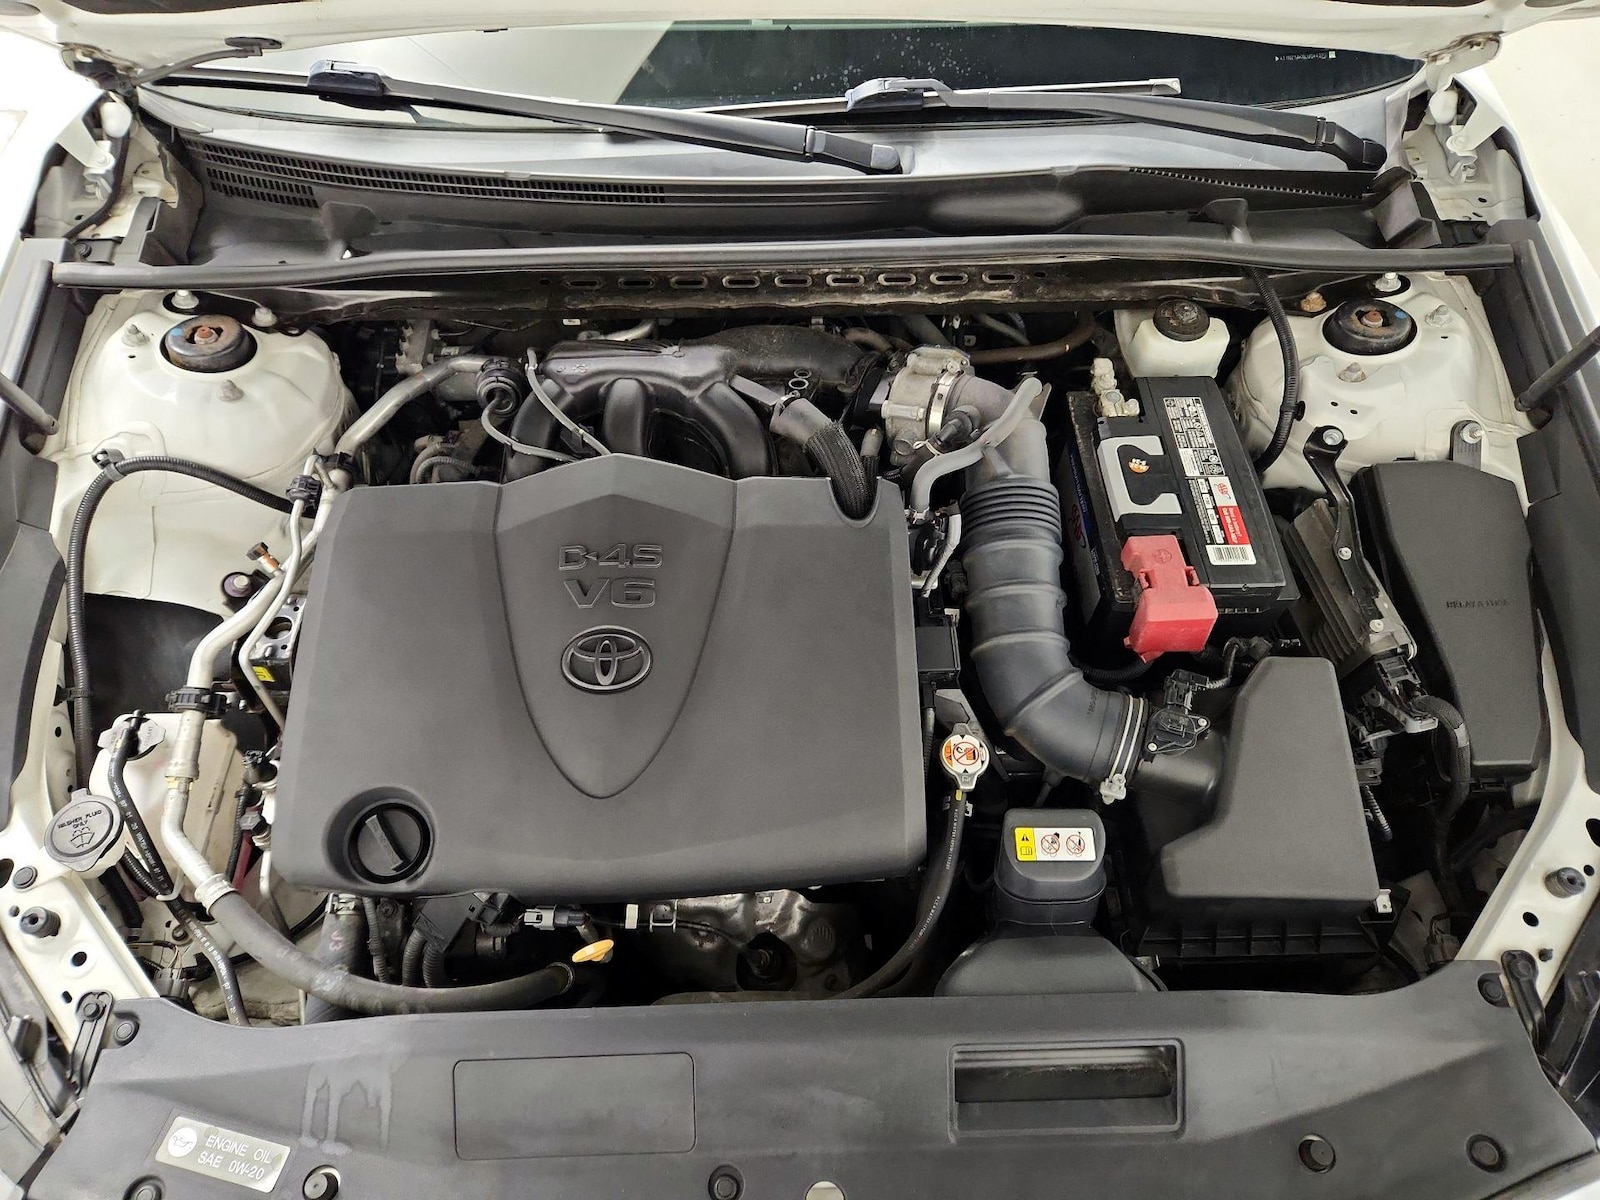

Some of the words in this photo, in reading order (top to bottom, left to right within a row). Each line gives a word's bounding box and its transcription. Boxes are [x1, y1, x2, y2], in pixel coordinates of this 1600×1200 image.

[563, 578, 656, 609] V6
[205, 1135, 250, 1156] ENGINE
[253, 1149, 271, 1164] OIL
[198, 1152, 223, 1168] SAE
[228, 1160, 265, 1180] 0W-20
